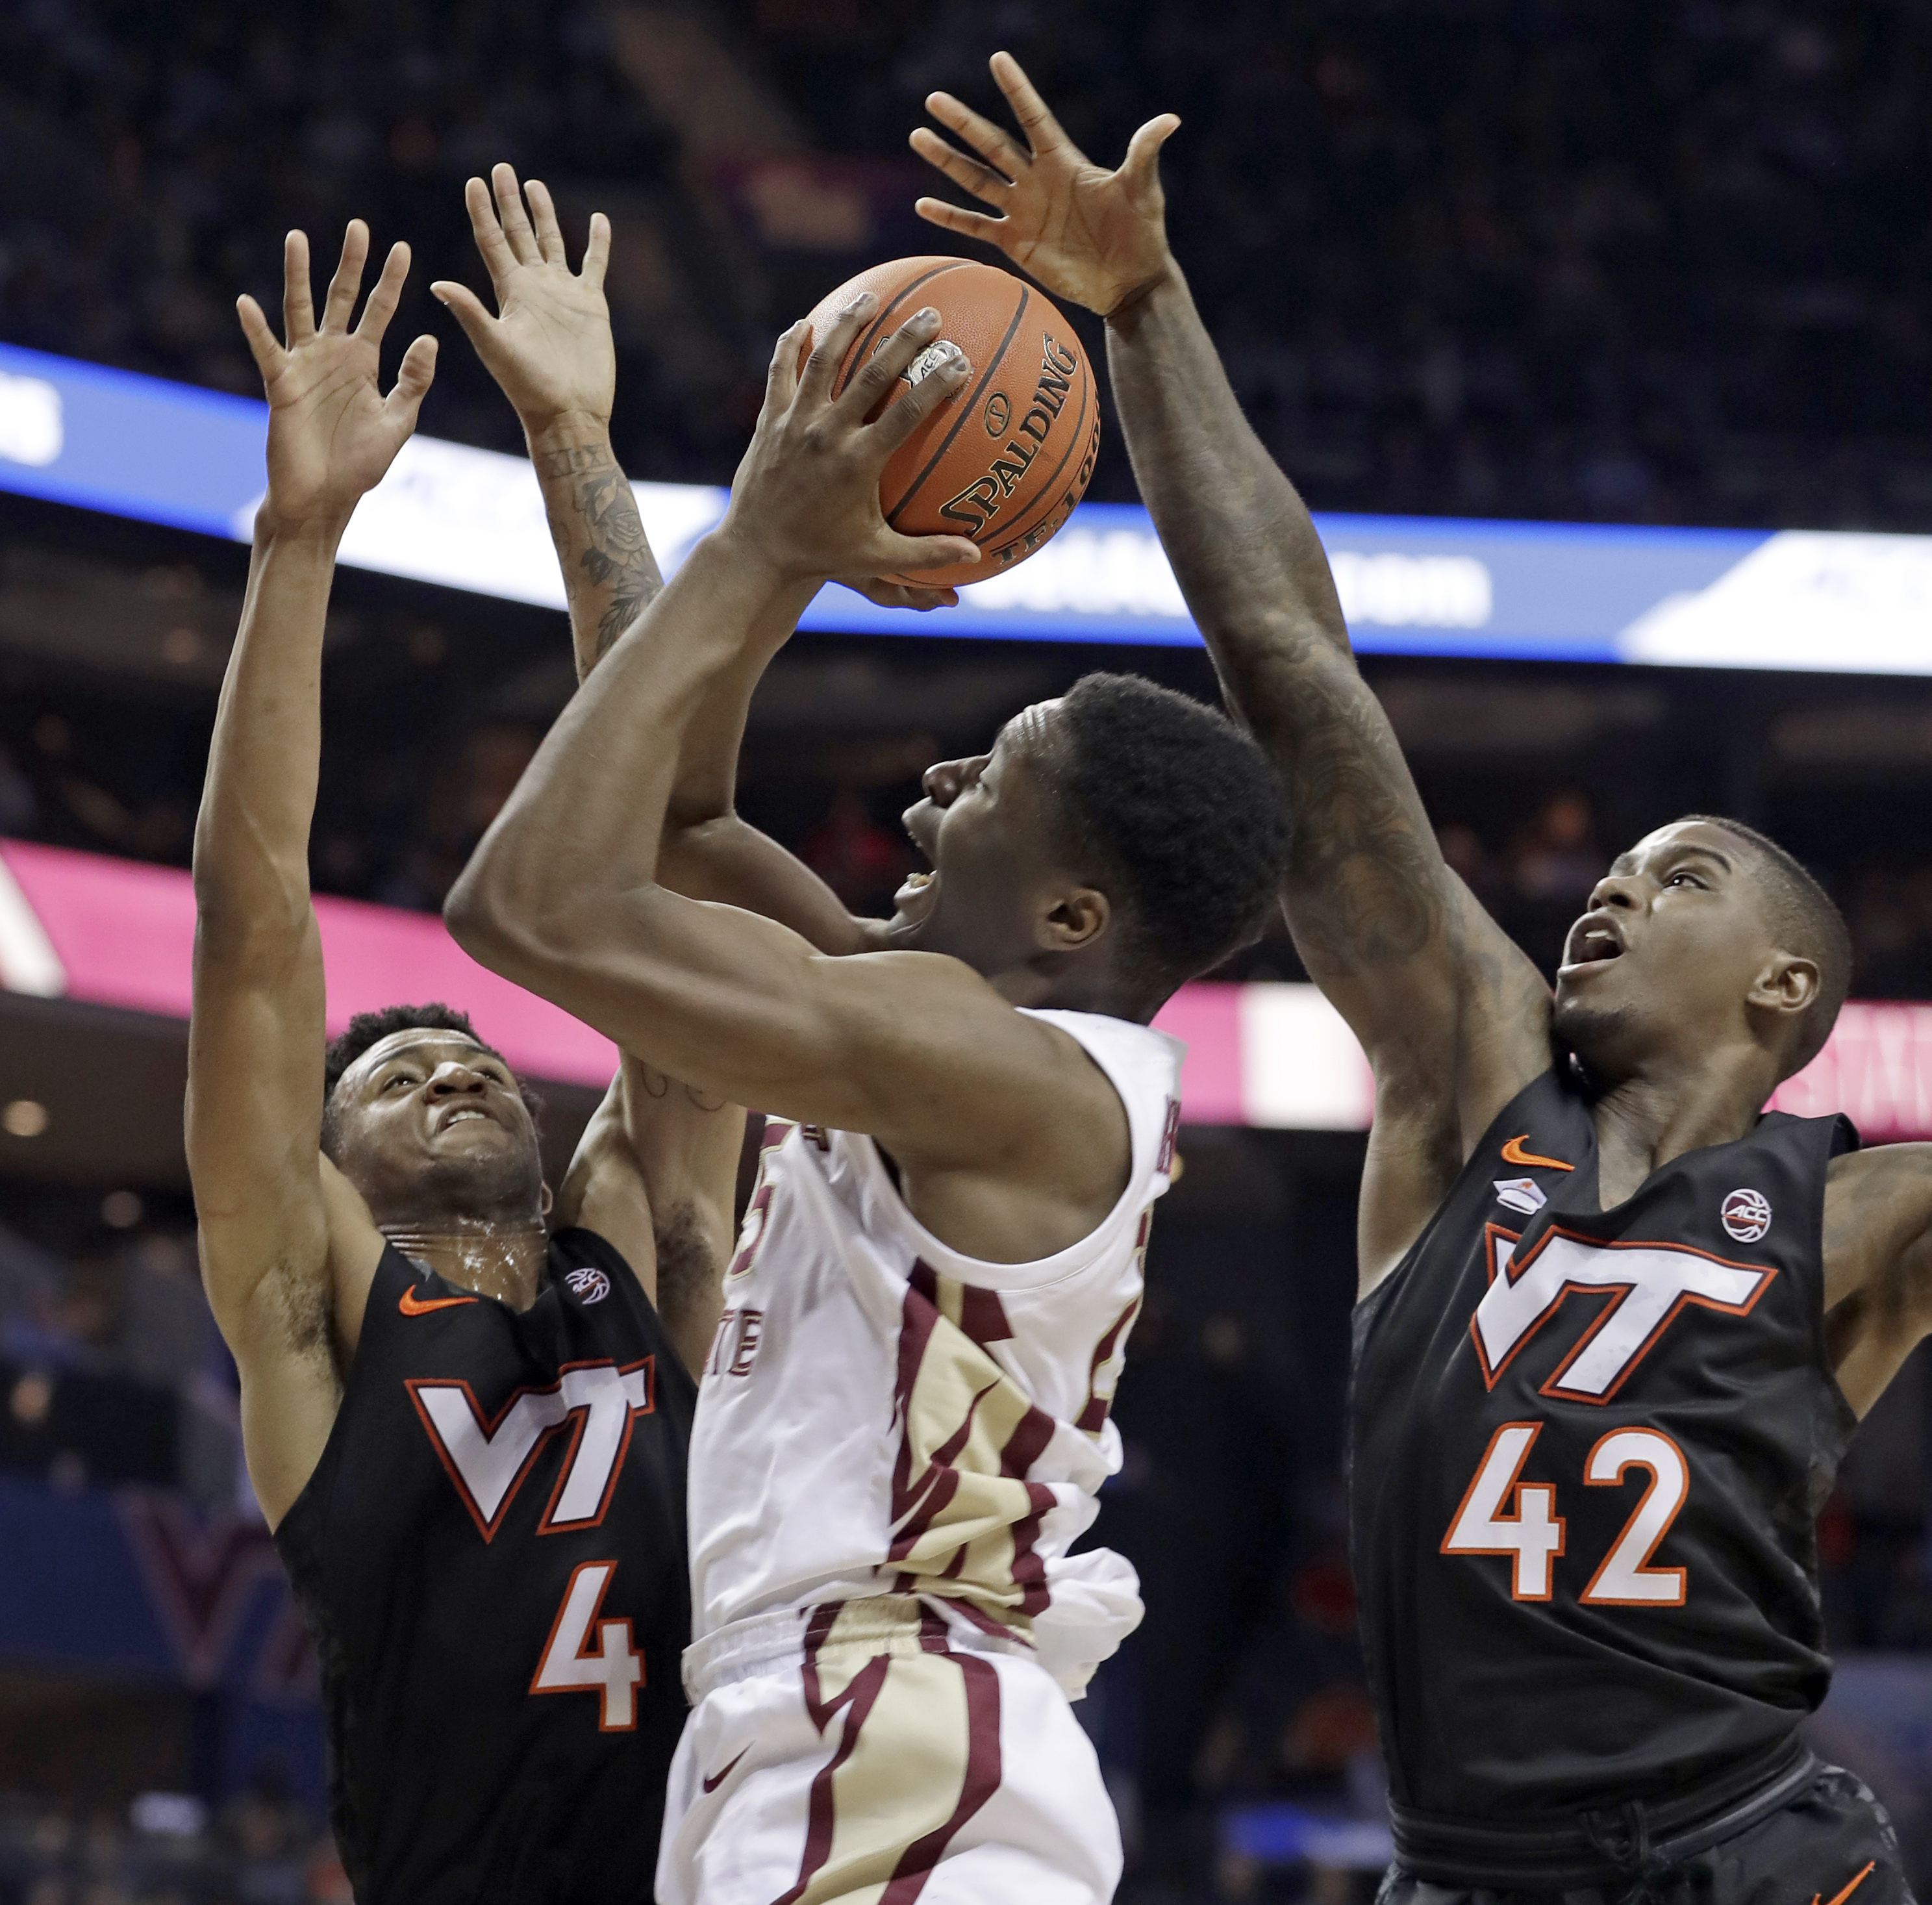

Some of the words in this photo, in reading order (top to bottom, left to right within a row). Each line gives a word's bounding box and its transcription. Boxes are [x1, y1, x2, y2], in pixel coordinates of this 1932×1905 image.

[939, 330, 1079, 538] SPALDING
[1470, 1222, 1779, 1406] VT
[404, 1355, 655, 1545] VT
[1439, 1421, 1690, 1606] 42
[529, 1559, 646, 1732] 4
